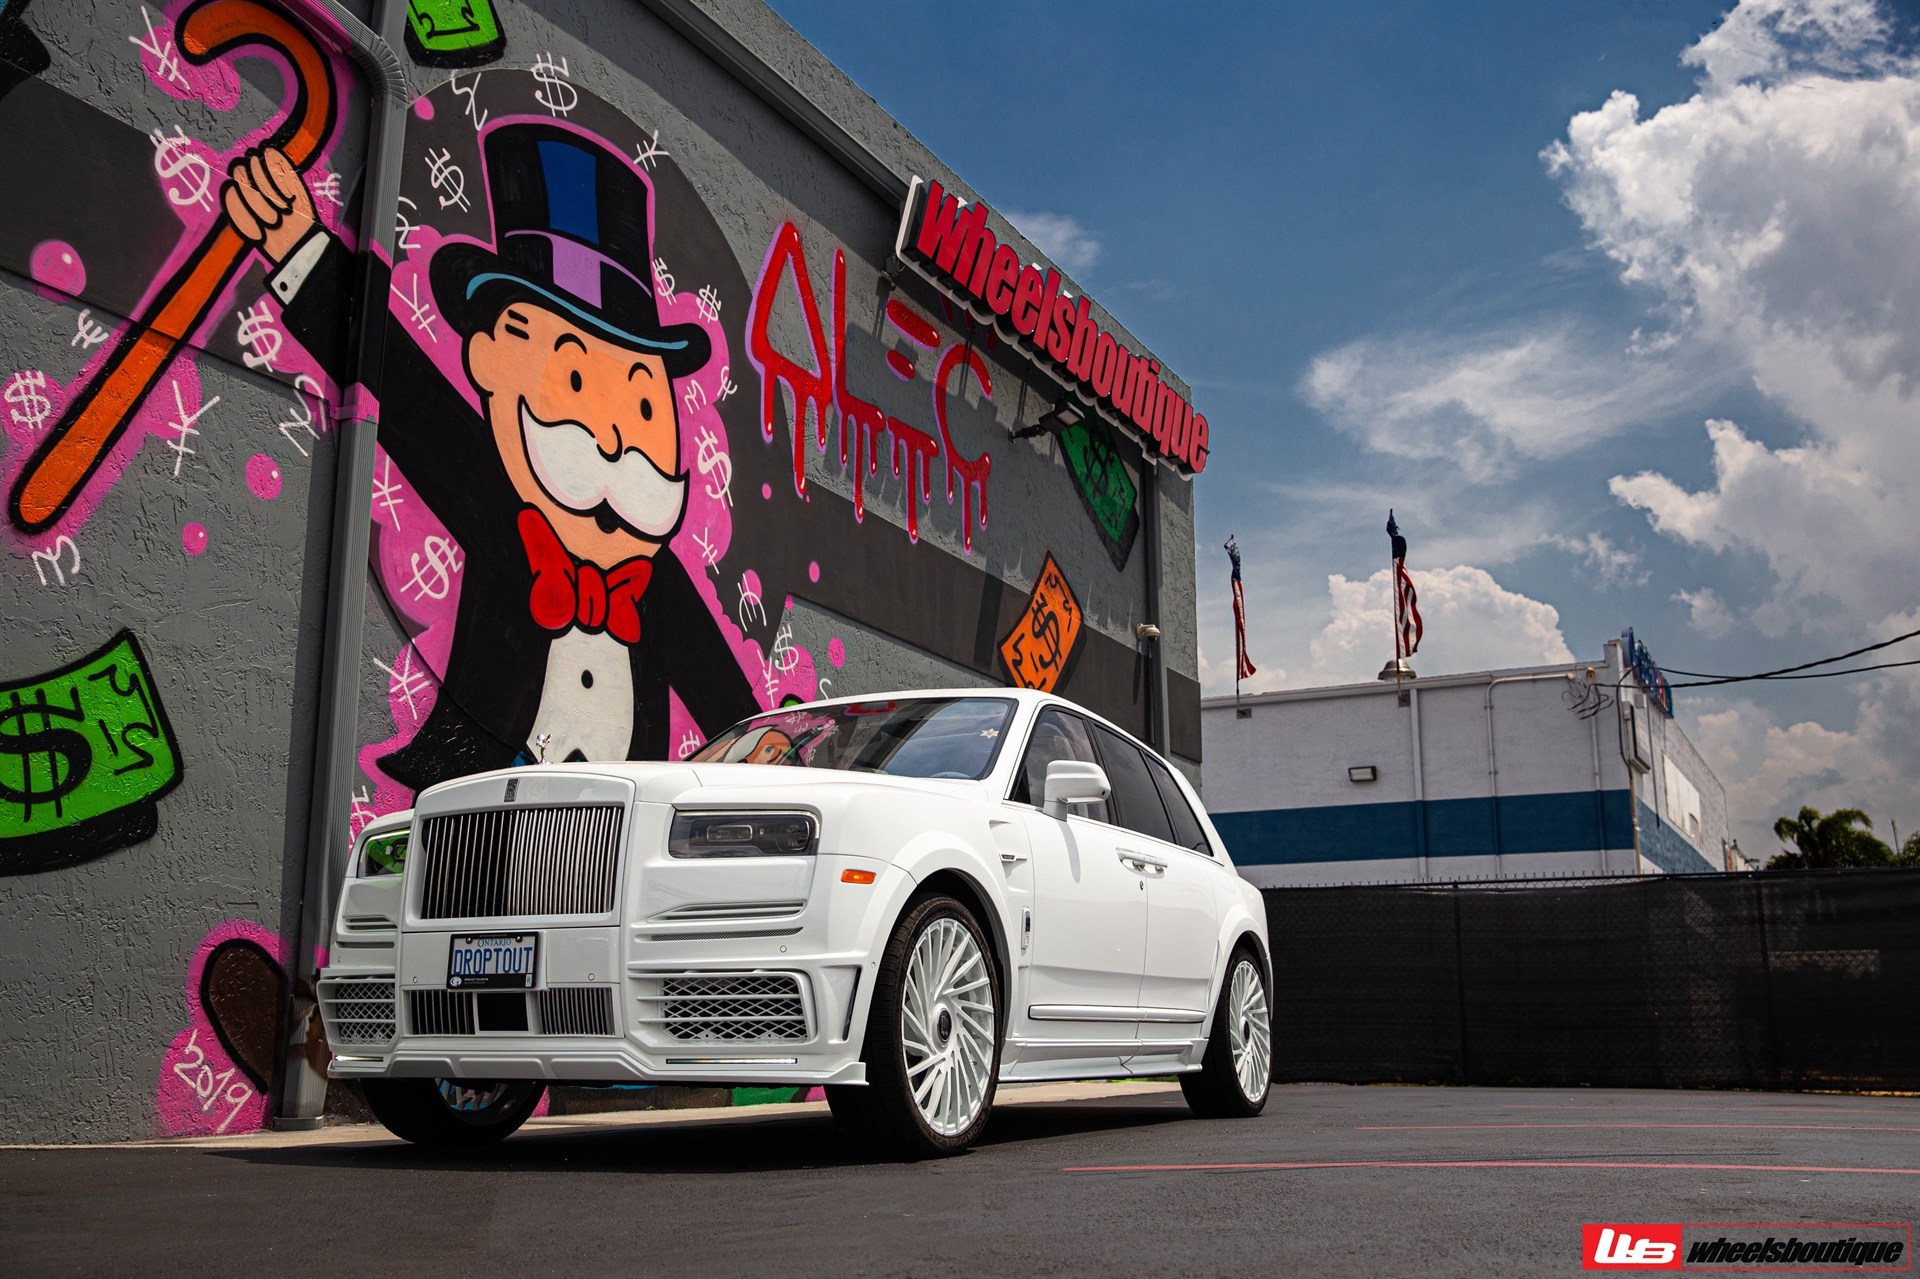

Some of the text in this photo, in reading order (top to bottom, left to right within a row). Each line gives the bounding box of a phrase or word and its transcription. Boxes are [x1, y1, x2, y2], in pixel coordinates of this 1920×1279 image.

[916, 179, 1210, 474] wheelsboutique
[453, 946, 533, 975] DROPTOUT
[477, 937, 512, 948] ONTARIO
[173, 1028, 253, 1134] 2019
